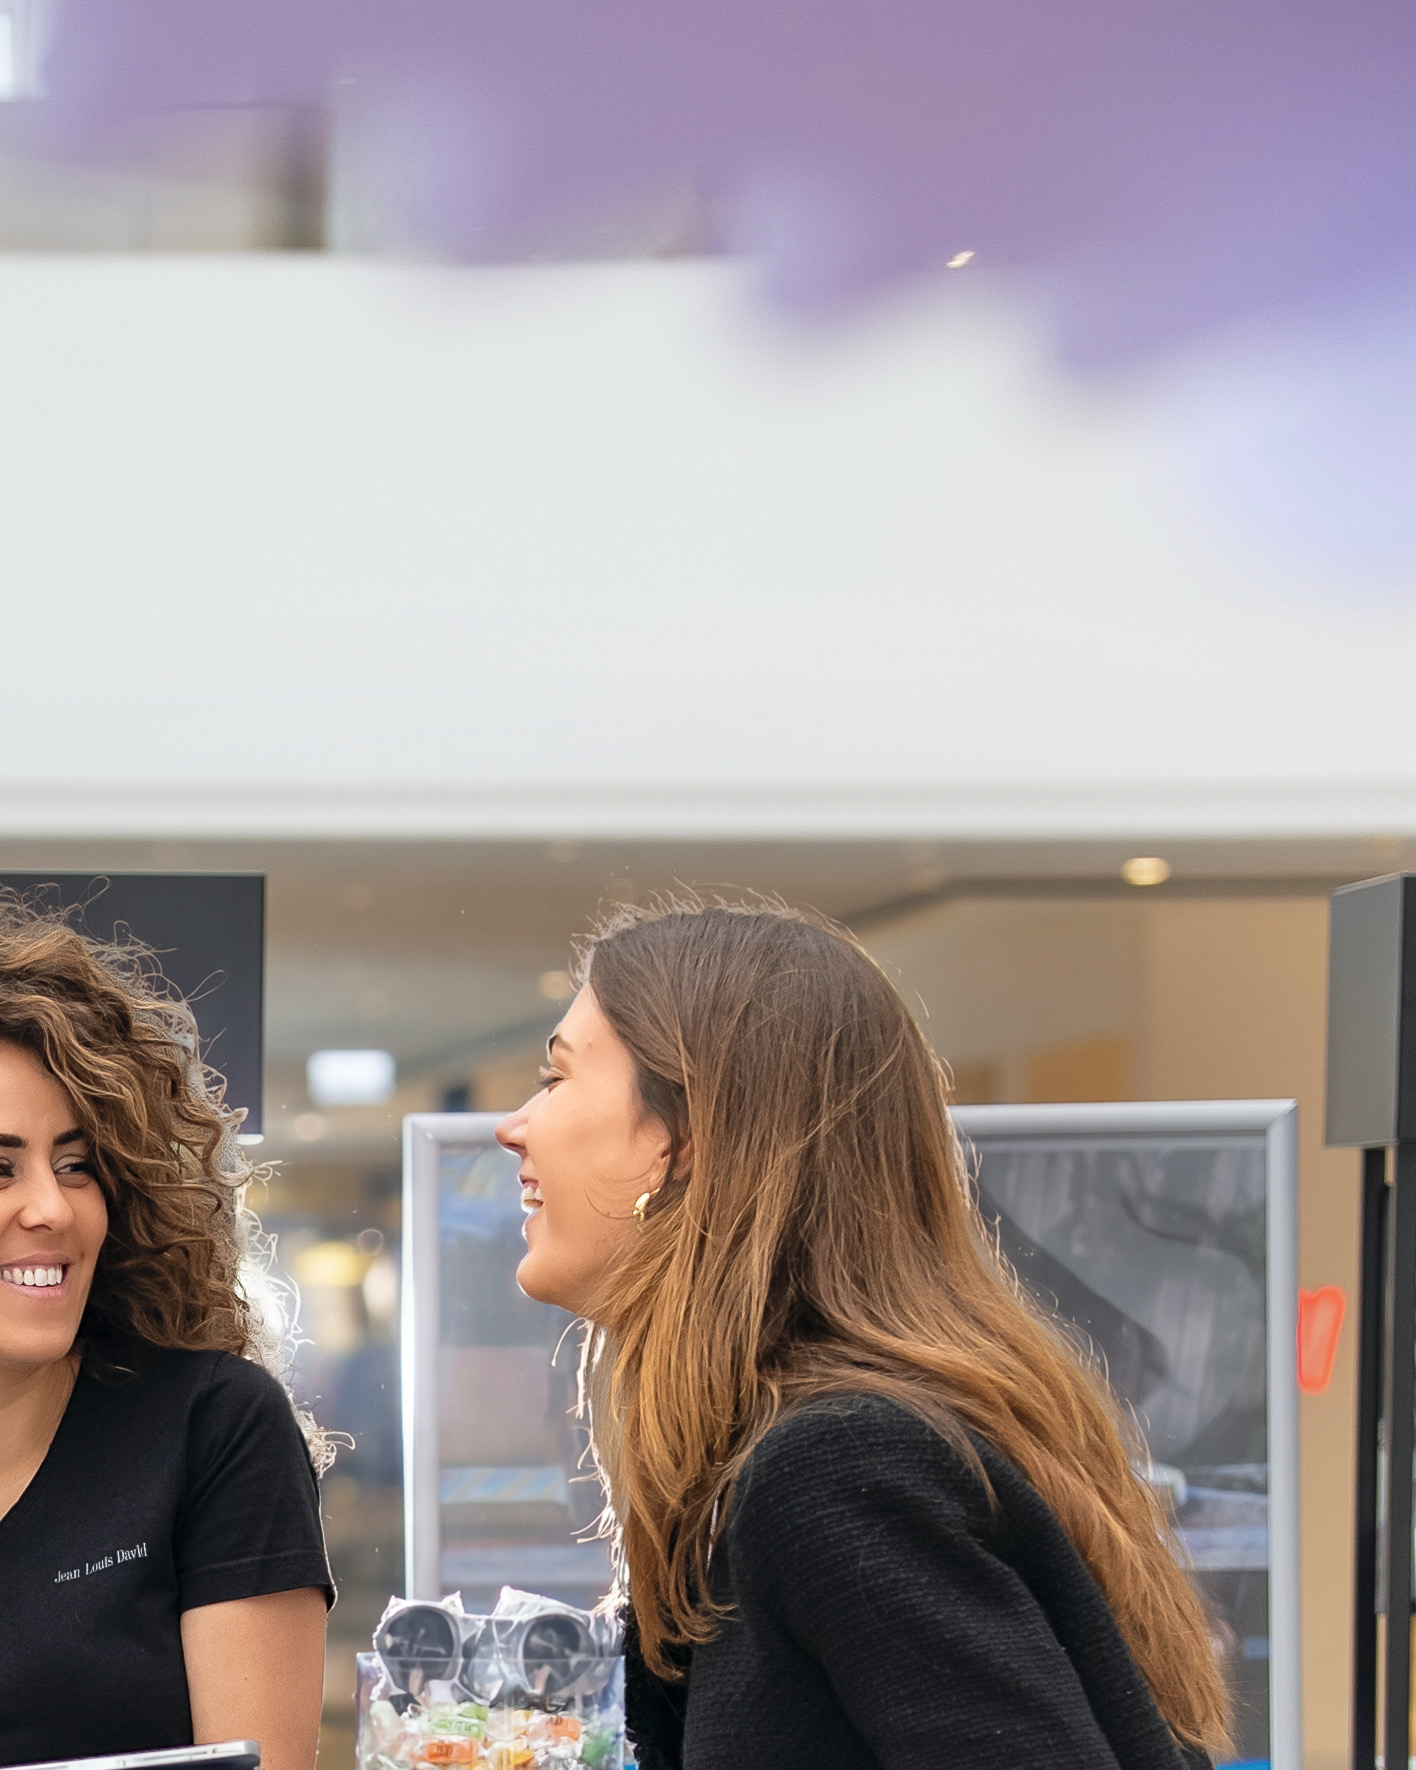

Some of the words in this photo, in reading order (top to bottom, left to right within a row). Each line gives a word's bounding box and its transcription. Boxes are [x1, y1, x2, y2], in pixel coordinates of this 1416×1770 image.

[54, 1570, 80, 1583] Jean
[86, 1556, 114, 1575] Louis
[117, 1542, 148, 1563] David
